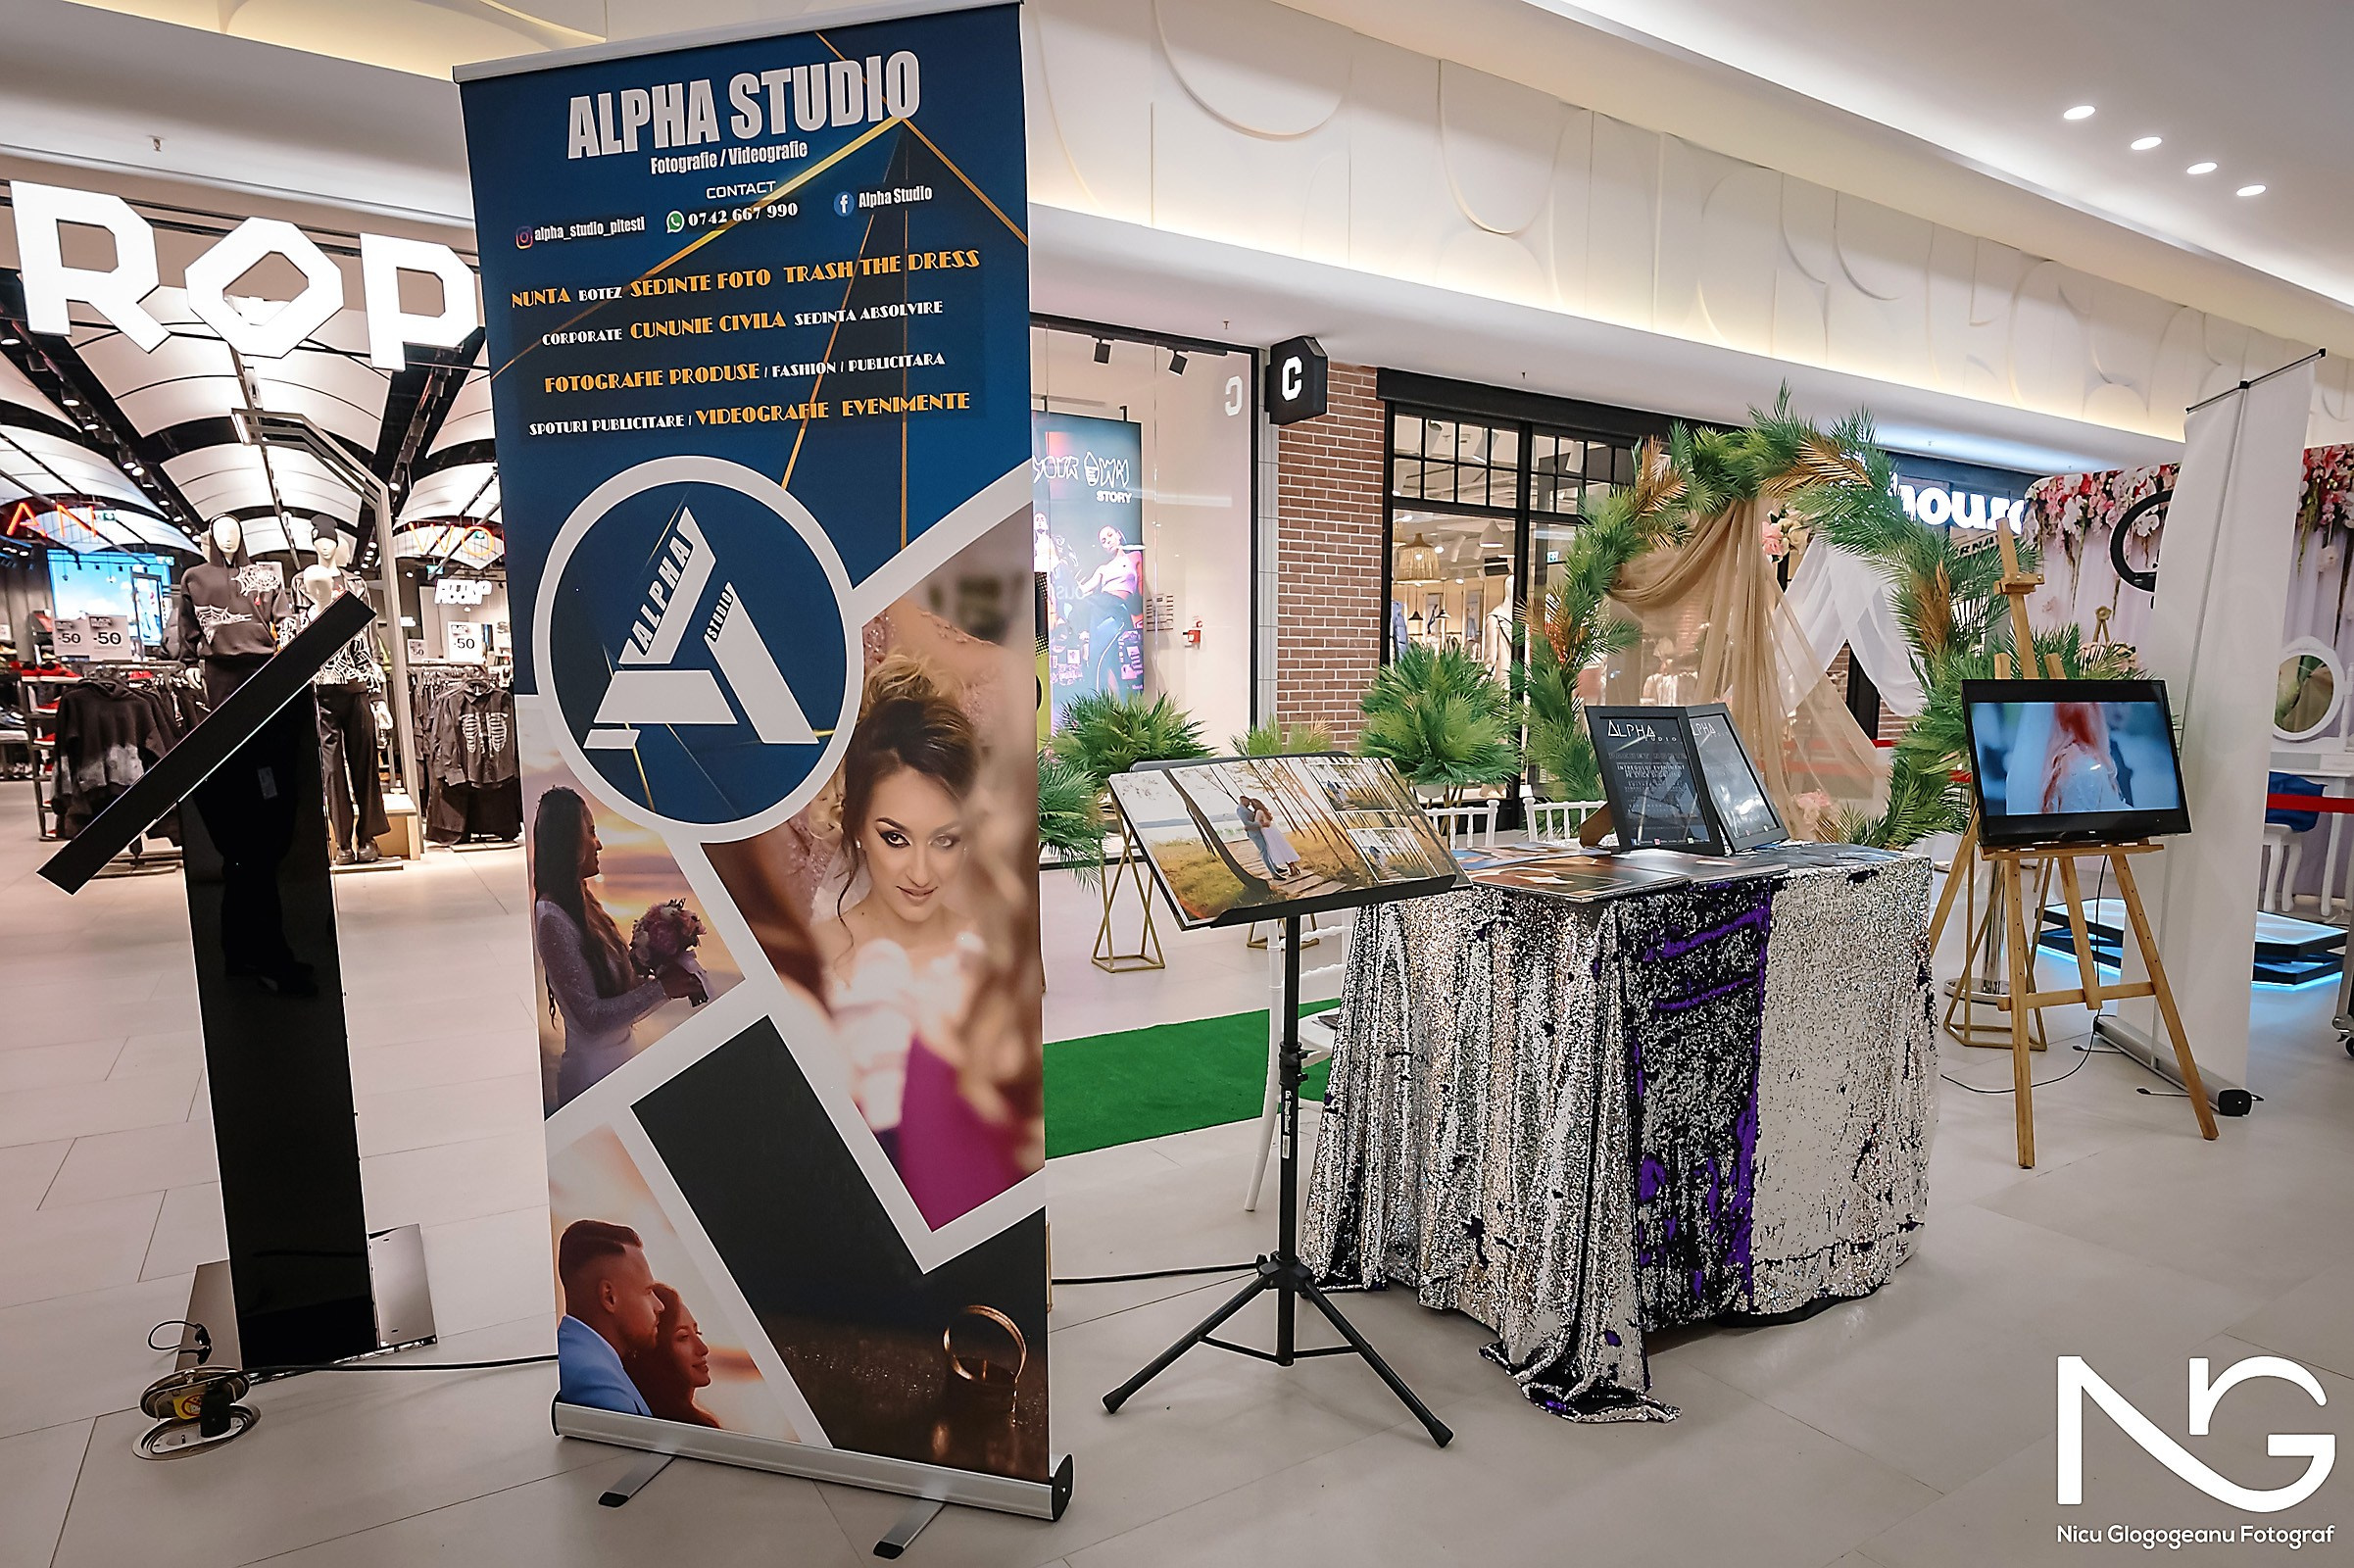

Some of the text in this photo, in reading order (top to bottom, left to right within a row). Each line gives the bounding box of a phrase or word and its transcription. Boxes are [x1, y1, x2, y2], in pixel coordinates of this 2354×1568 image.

[567, 51, 920, 159] ALPHA STUDIO
[651, 140, 808, 174] Fotografie / Videografie
[706, 180, 776, 199] CONTACT
[858, 185, 933, 209] Alpha Studio
[534, 216, 646, 243] alpha_studio_pitesti
[688, 202, 799, 226] 0742 667 990
[512, 249, 980, 308] NUNTA BOTEZ SEDINTE FOTO TRASH THE DRESS
[542, 300, 943, 346] CORPORATE CUNUNIE CIVILA SEDINTA ABSOLVIRE
[544, 369, 663, 393] FOTOGRAFIE
[669, 363, 760, 385] PRODUSE
[771, 361, 836, 378] FASHION
[849, 352, 946, 372] PUBLICITARA
[1282, 356, 1302, 402] C
[528, 419, 588, 436] SPOTURI
[592, 414, 684, 432] PUBLICITARE
[695, 402, 829, 425] VIDEOGRAFIE
[842, 392, 970, 416] EVENIMENTE
[1097, 491, 1132, 503] STORY
[408, 523, 506, 557] WO
[632, 536, 691, 652] ALPHA
[707, 590, 733, 640] STUDIO
[93, 632, 122, 645] -50
[1607, 719, 1656, 737] ALPHA
[1690, 722, 1716, 736] LPHA
